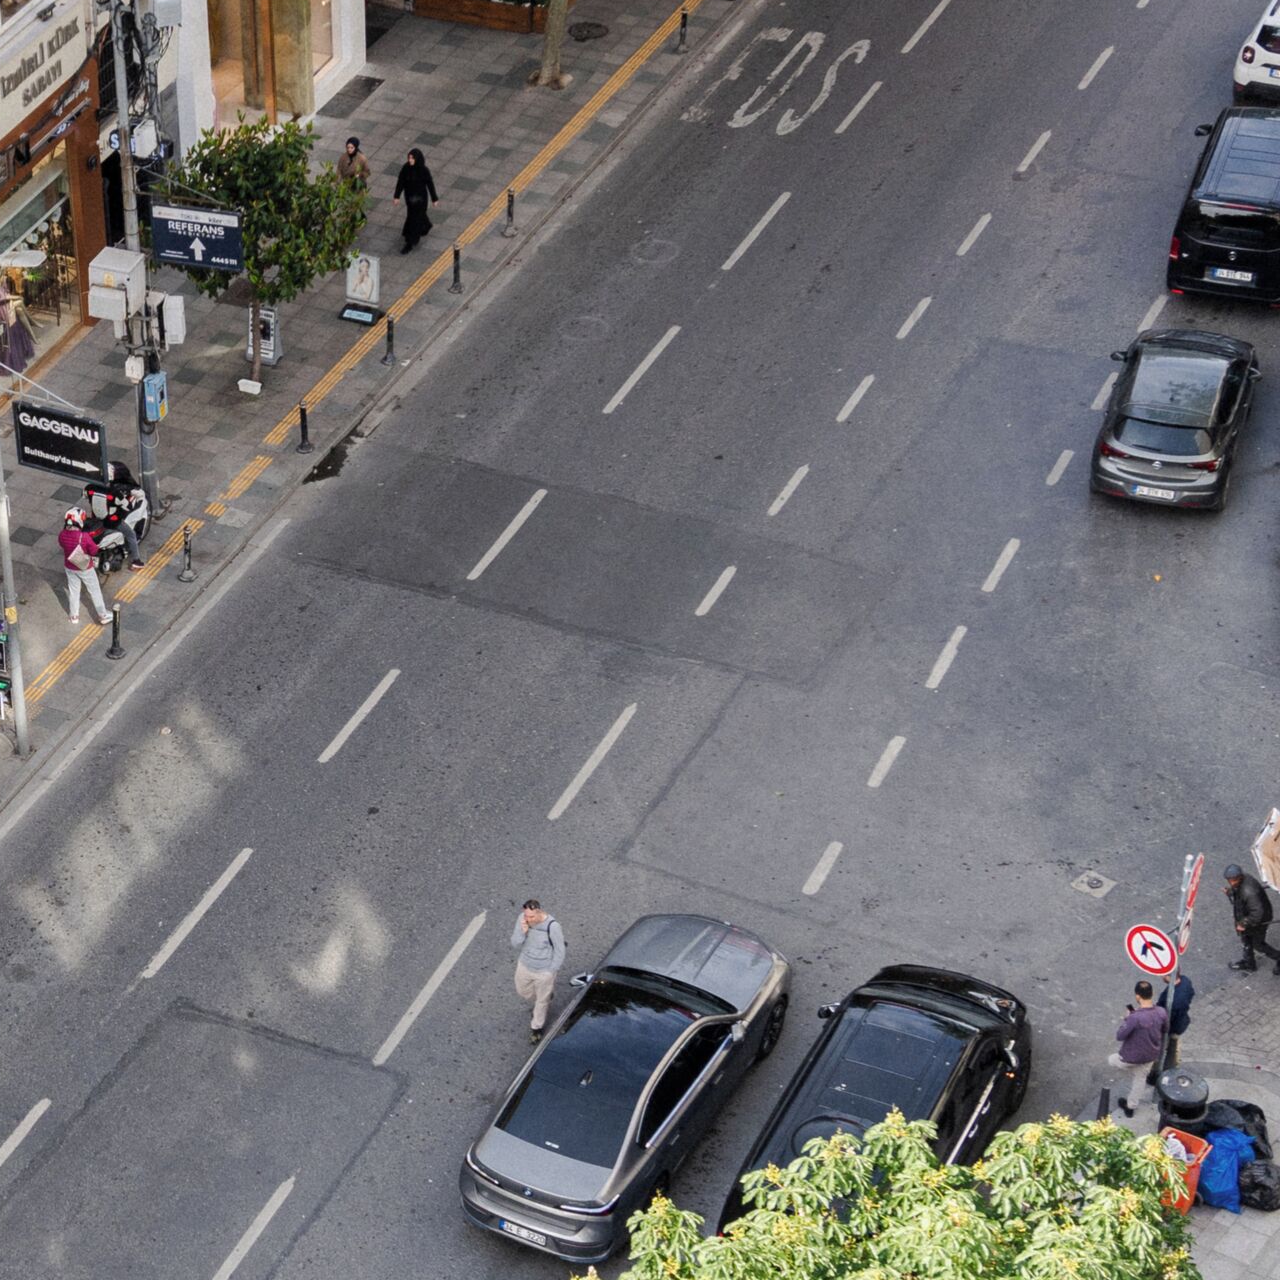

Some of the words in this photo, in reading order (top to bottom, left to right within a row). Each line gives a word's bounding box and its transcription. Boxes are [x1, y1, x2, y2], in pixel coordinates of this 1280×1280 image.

[22, 59, 62, 107] SARAYI
[168, 220, 224, 236] REFERANS
[19, 412, 99, 444] GAGGENAU
[24, 446, 71, 465] Bulthaup'da
